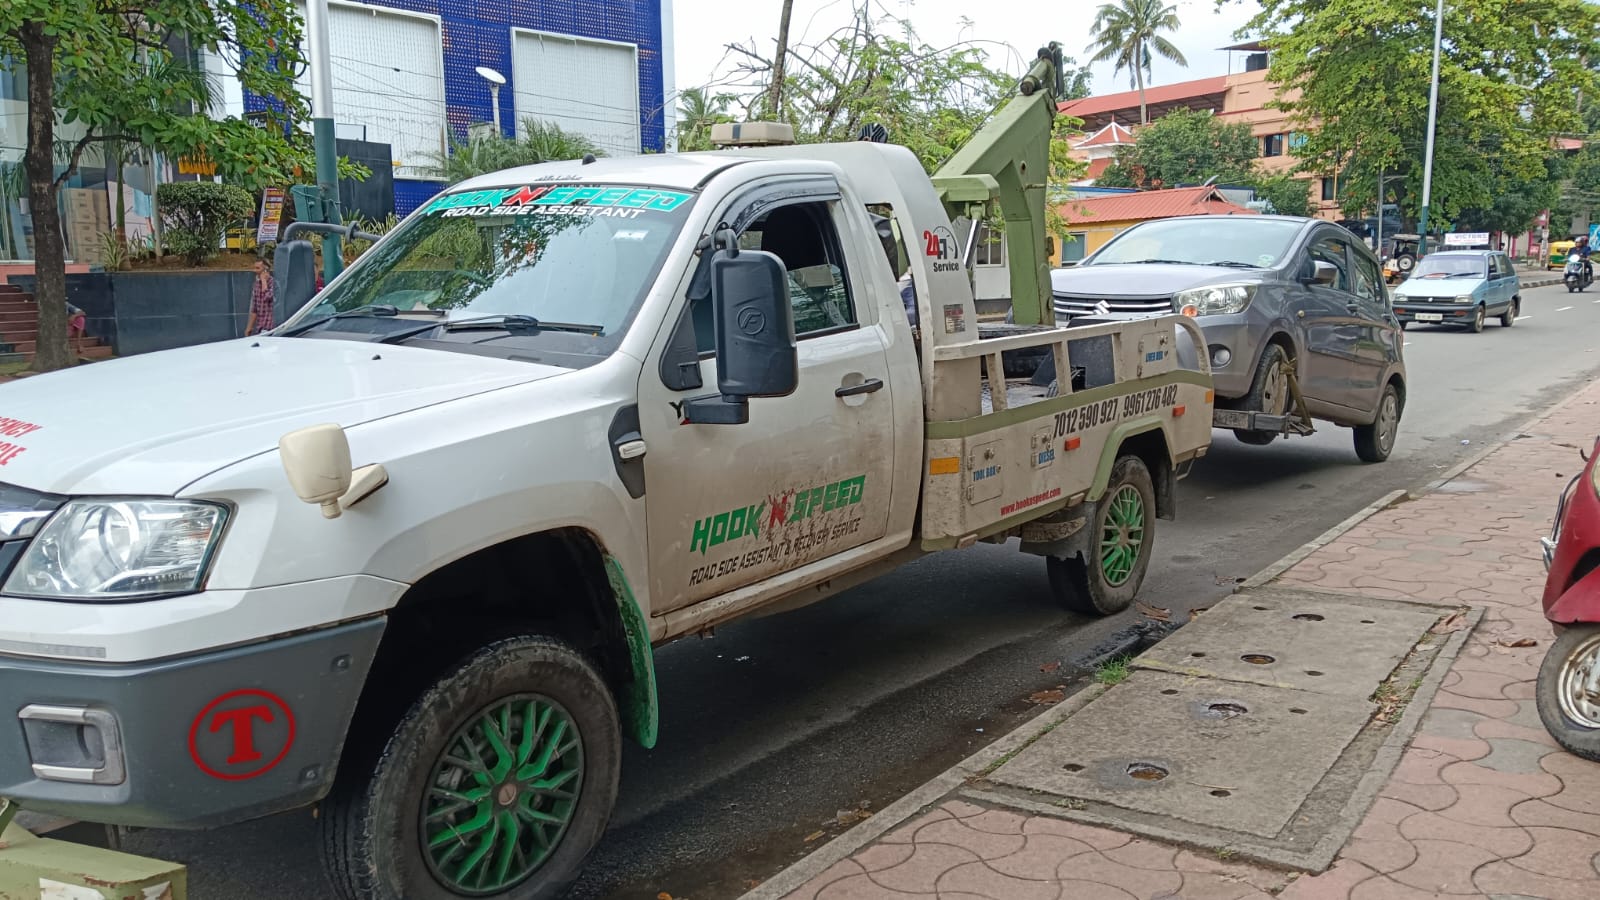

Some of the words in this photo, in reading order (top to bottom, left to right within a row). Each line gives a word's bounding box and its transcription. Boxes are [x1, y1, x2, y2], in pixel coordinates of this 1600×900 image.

[419, 187, 524, 217] HOOK
[530, 186, 695, 213] SPEED
[441, 207, 490, 218] ROAD
[489, 206, 534, 215] SIDE
[531, 205, 646, 219] ASSISTANT
[933, 262, 960, 273] Service
[1053, 409, 1079, 439] 7012
[1078, 403, 1100, 431] 590
[1122, 392, 1146, 418] 9961
[1145, 387, 1162, 413] 276
[1160, 383, 1179, 408] 482
[1038, 449, 1056, 465] DIESEL
[972, 468, 986, 482] TOOL
[985, 465, 997, 478] BOX
[689, 500, 766, 556] HOOK
[787, 474, 866, 523] SPEED
[688, 563, 718, 587] ROAD
[717, 556, 740, 577] SIDE
[737, 540, 787, 571] ASSISTANT
[792, 526, 832, 554] RECOVERY
[830, 517, 862, 541] SERVICE
[208, 704, 275, 765] T
